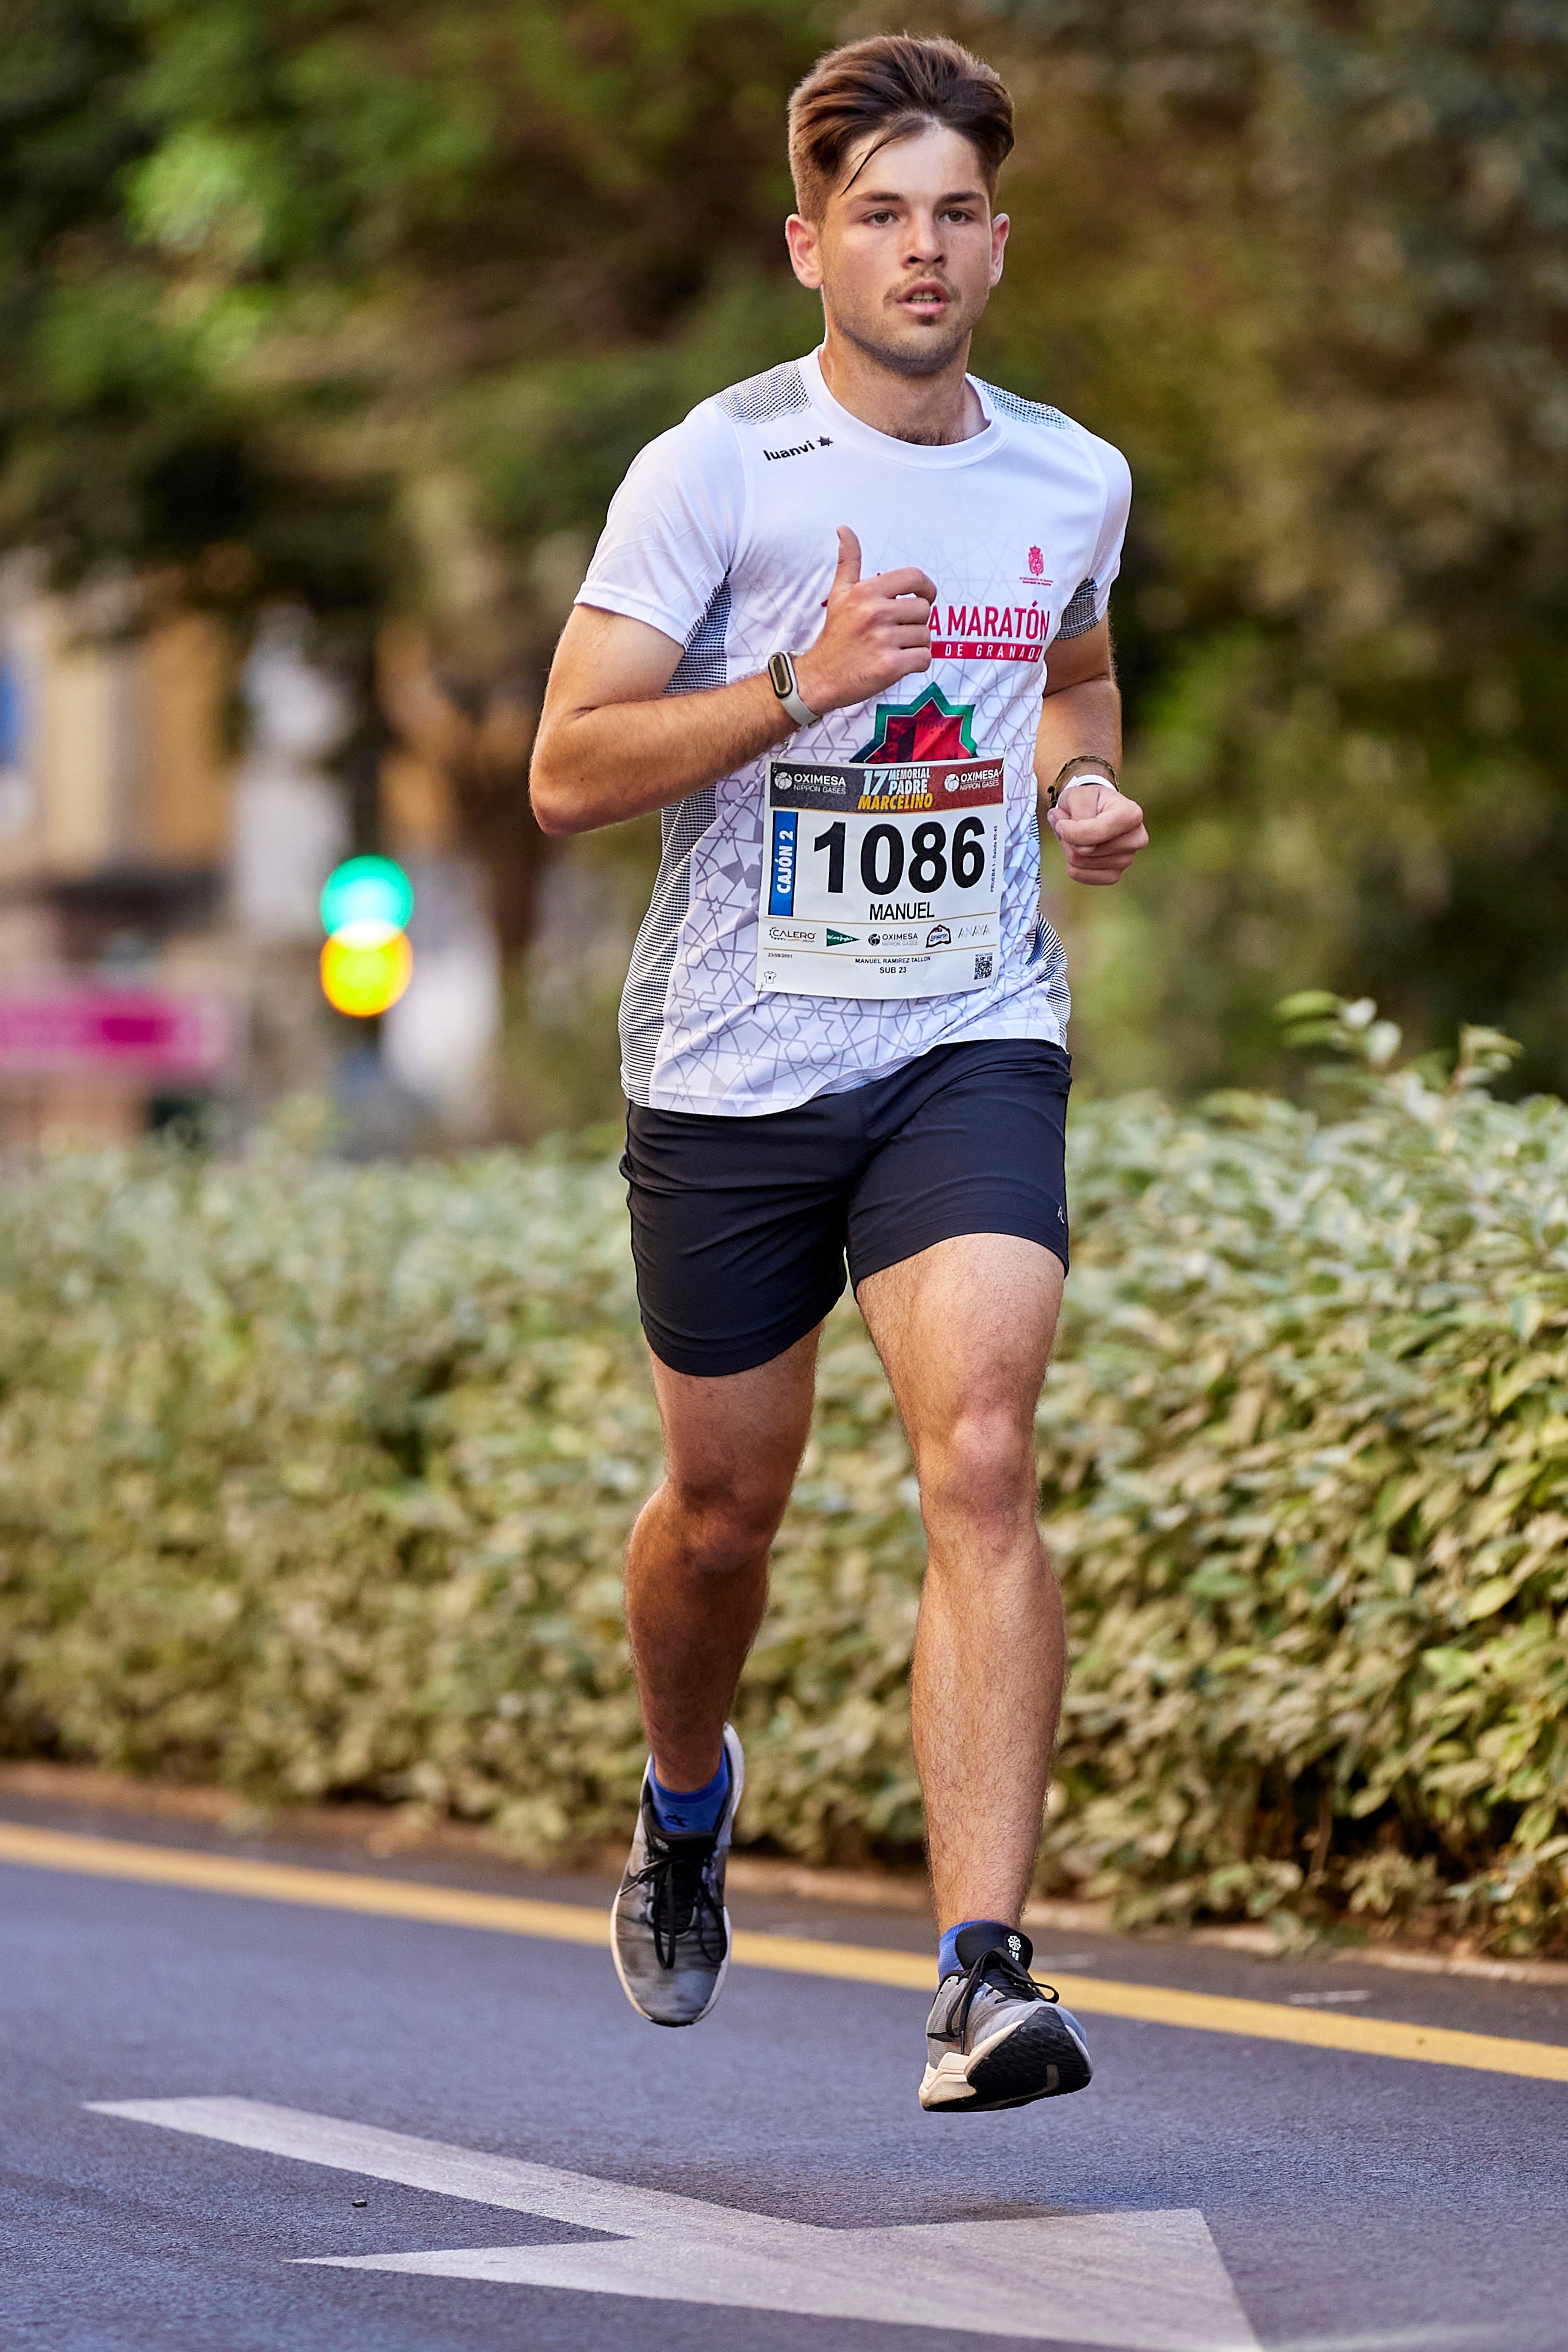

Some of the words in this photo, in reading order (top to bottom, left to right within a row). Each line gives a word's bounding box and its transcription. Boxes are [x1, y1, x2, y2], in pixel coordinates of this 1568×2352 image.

[763, 440, 815, 461] luanvi
[948, 600, 1050, 640] MARATÓN
[945, 644, 963, 656] DE
[794, 774, 846, 787] OXIMESA
[888, 767, 931, 780] MEMORIAL
[960, 769, 999, 783] OXIMESA
[793, 784, 821, 793] NIPPON
[823, 786, 847, 794] GASES
[862, 770, 889, 796] 17
[888, 779, 928, 796] PADRE
[959, 783, 981, 791] NIPPON
[982, 780, 999, 788] GASES
[857, 793, 933, 810] MARCELINO
[779, 830, 794, 841] 2
[814, 816, 985, 896] 1086
[775, 846, 793, 894] CAJÓN
[870, 901, 935, 920] MANUEL
[773, 929, 815, 940] CALERO
